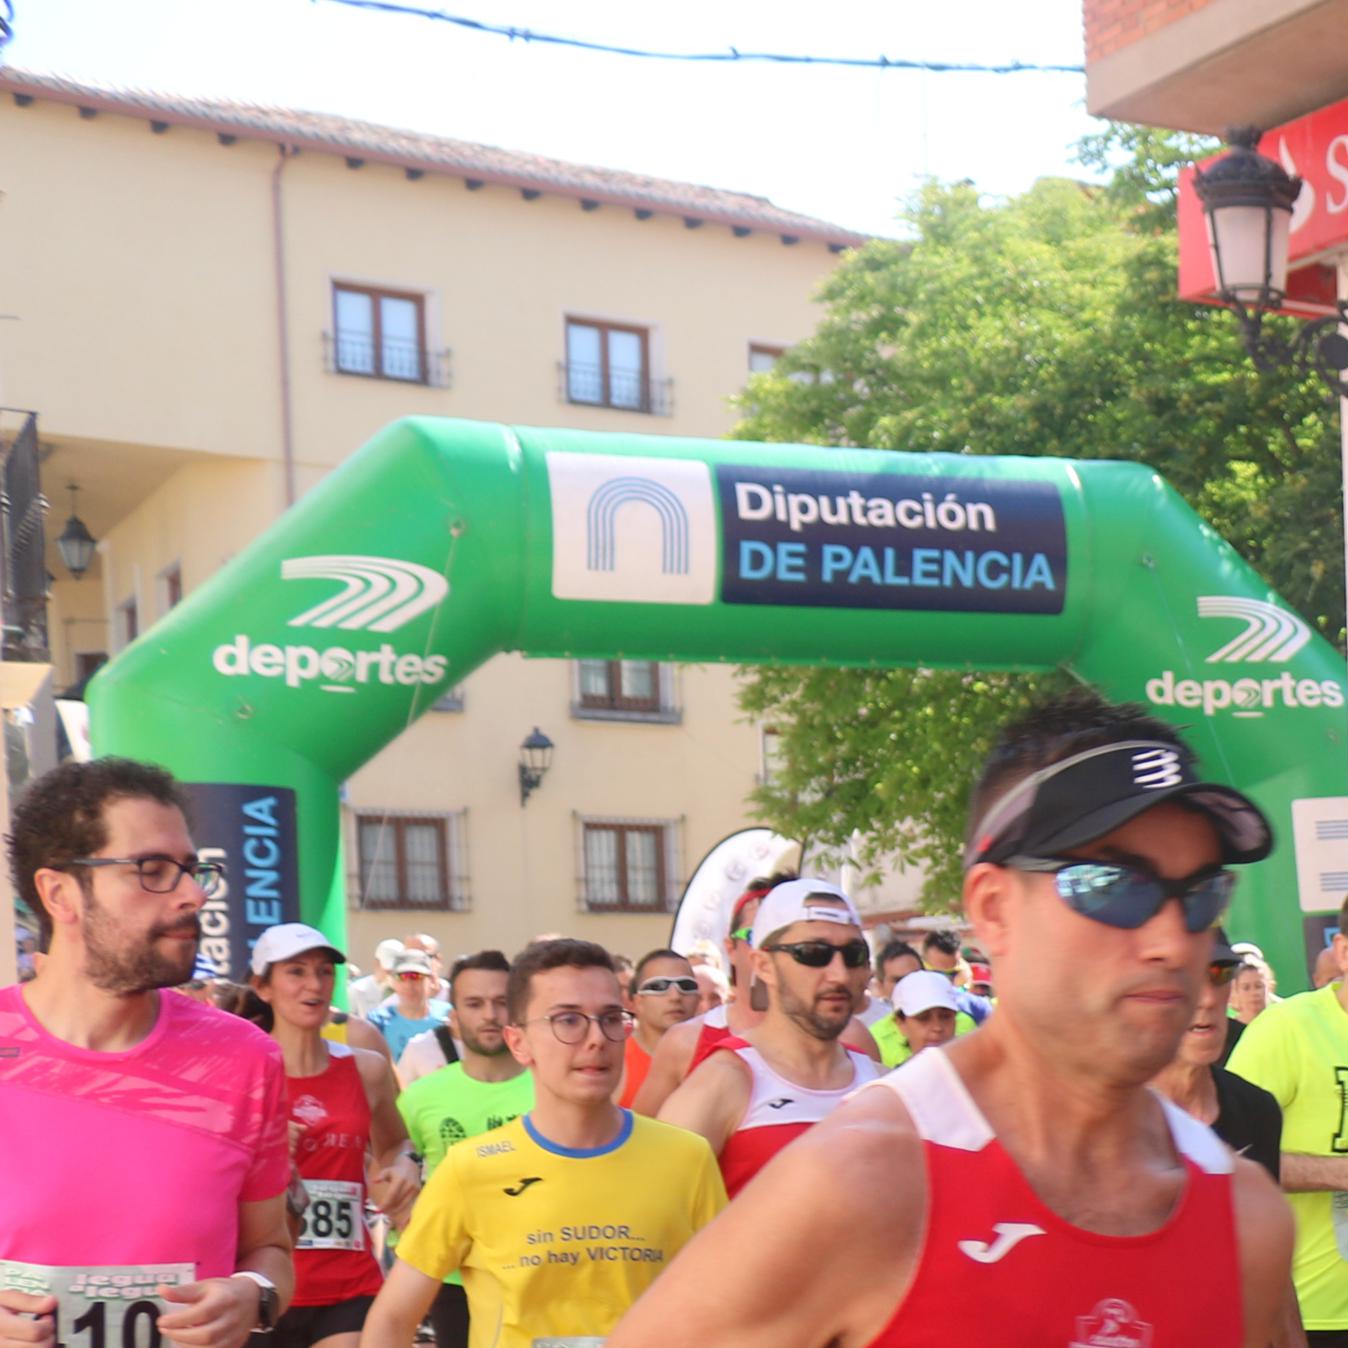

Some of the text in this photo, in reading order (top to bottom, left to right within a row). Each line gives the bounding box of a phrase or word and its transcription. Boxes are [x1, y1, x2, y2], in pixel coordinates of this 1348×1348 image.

[735, 481, 997, 532] Diputación
[739, 540, 1056, 592] DE PALENCIA
[212, 633, 449, 689] deportes
[1144, 670, 1345, 716] deportes
[520, 1252, 541, 1267] no
[547, 1249, 580, 1265] hay
[527, 1228, 554, 1245] sin
